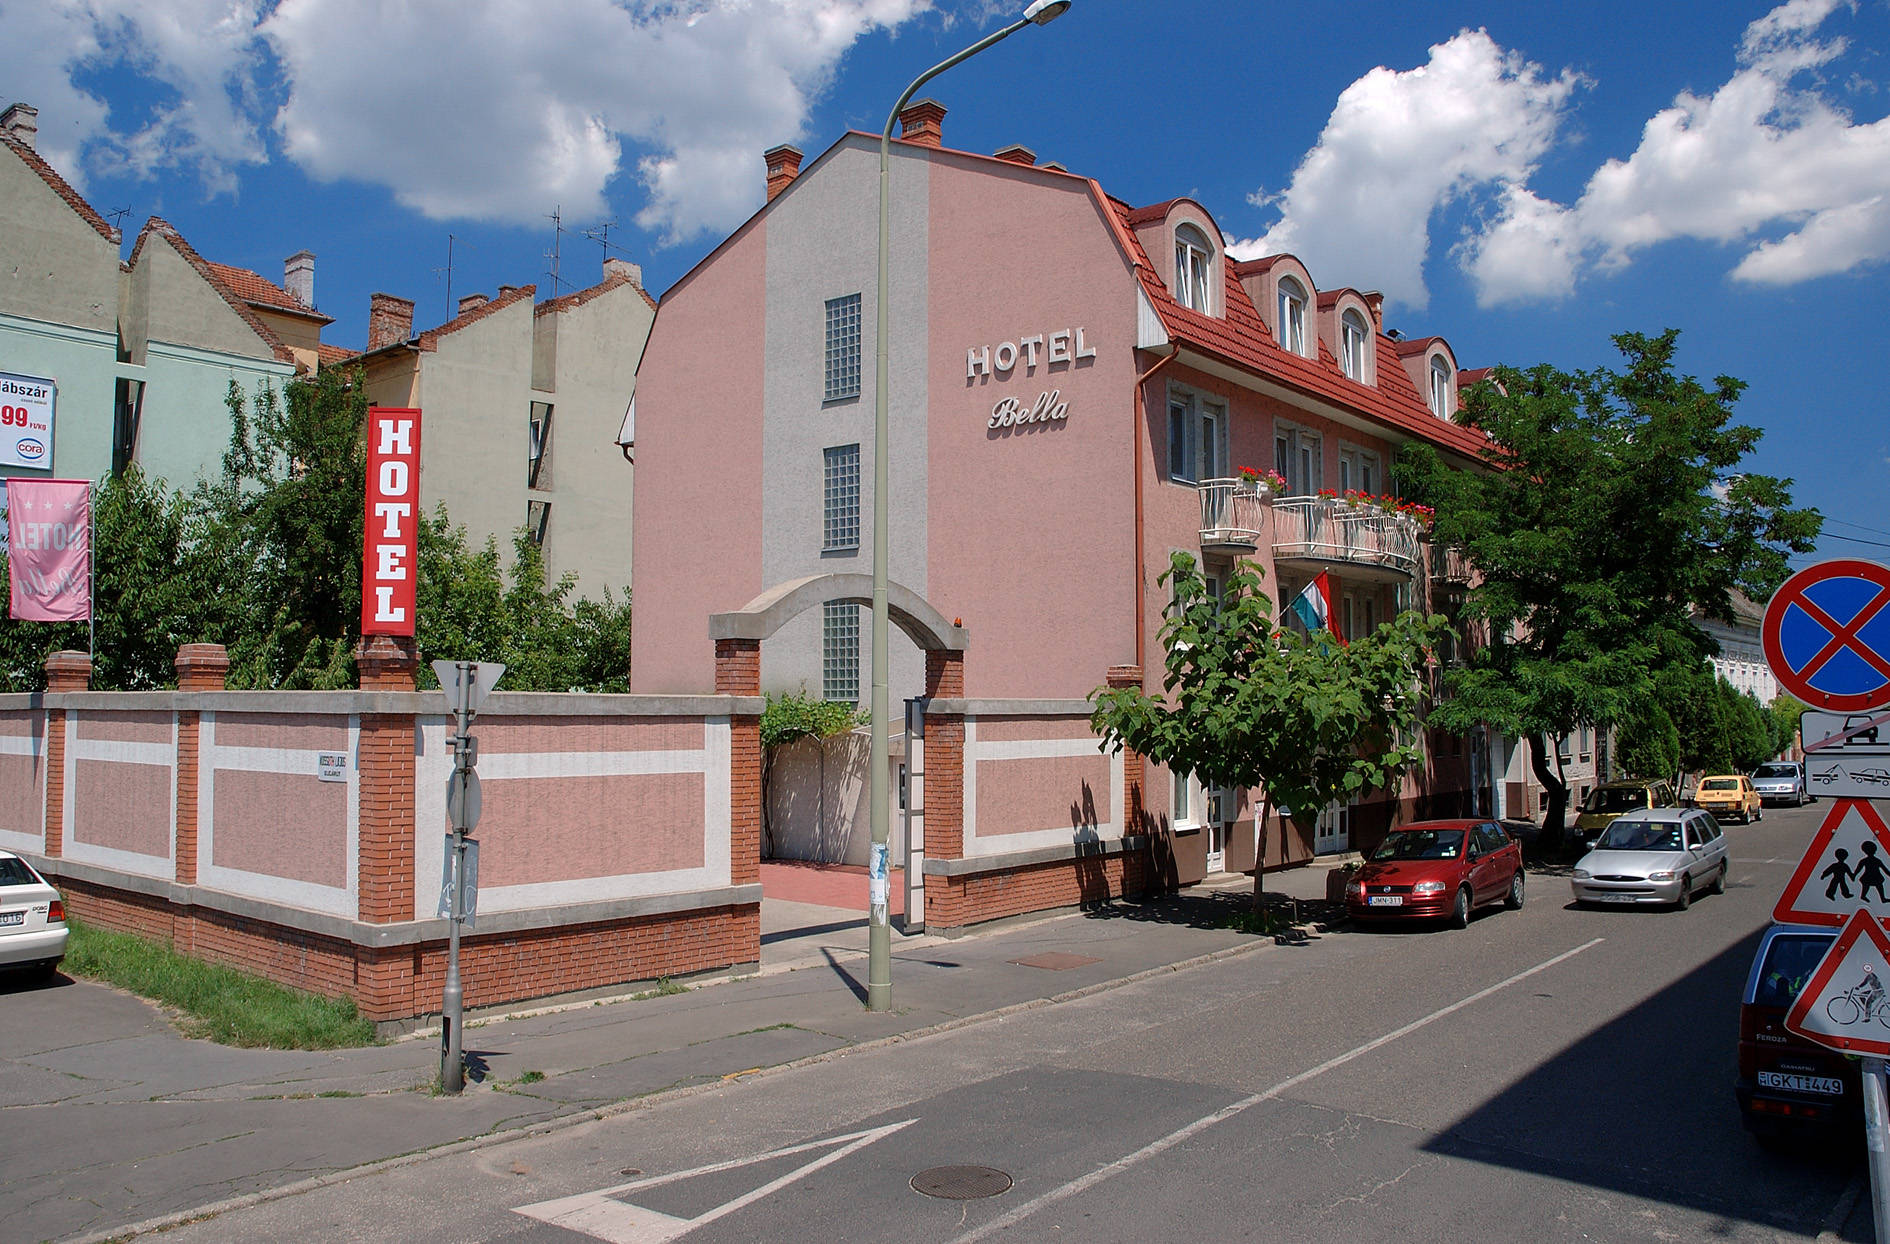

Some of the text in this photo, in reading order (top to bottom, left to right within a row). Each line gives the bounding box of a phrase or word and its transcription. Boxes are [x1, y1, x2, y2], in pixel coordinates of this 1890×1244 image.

[967, 327, 1096, 377] HOTEL
[0, 381, 47, 398] ábszár
[988, 390, 1069, 429] Bella
[18, 443, 42, 454] cora
[375, 419, 413, 622] HOTEL
[1756, 1033, 1788, 1043] FEROZA
